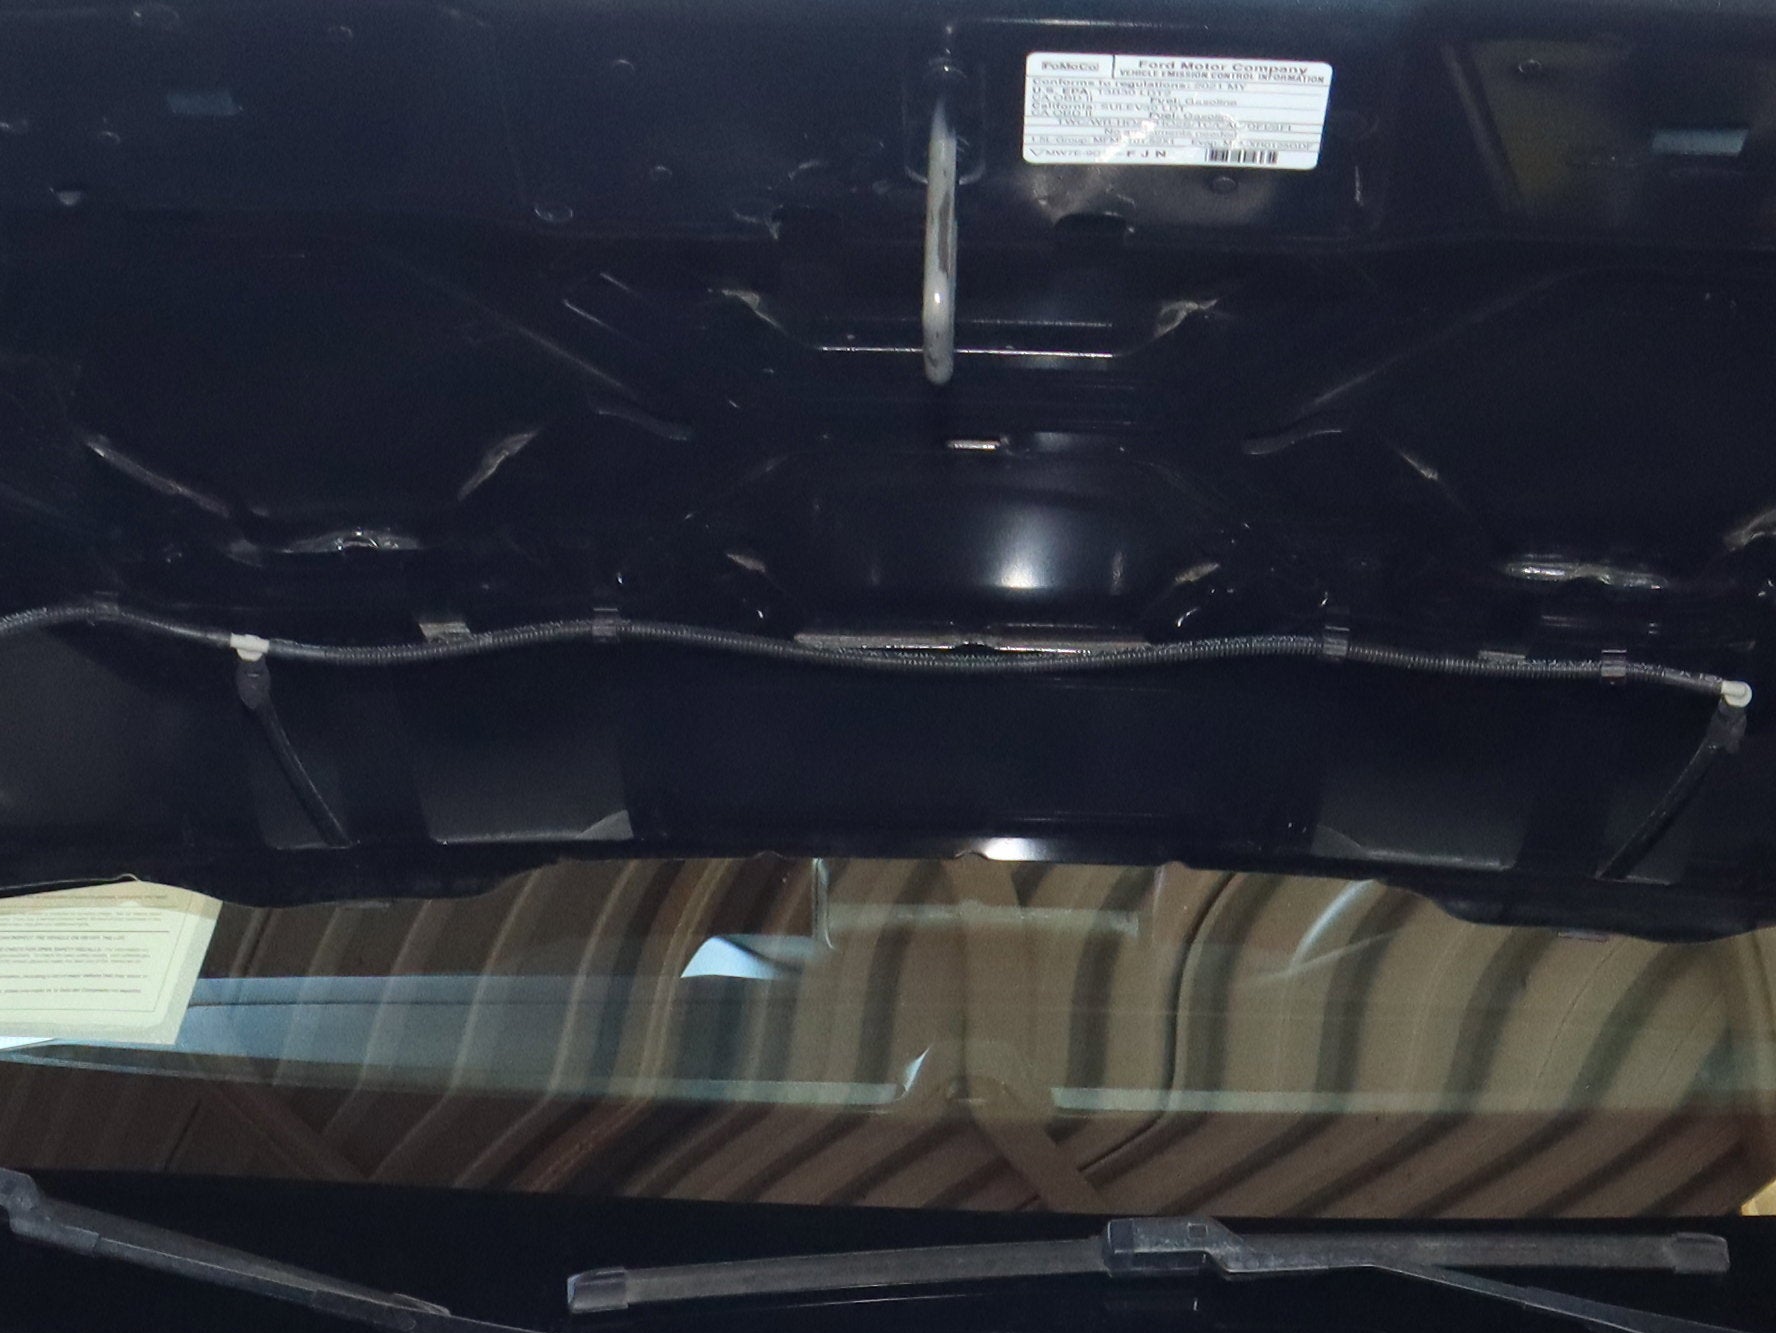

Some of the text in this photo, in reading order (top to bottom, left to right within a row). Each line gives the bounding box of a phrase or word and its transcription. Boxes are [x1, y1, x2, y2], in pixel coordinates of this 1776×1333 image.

[1138, 60, 1309, 76] Ford Motor Company
